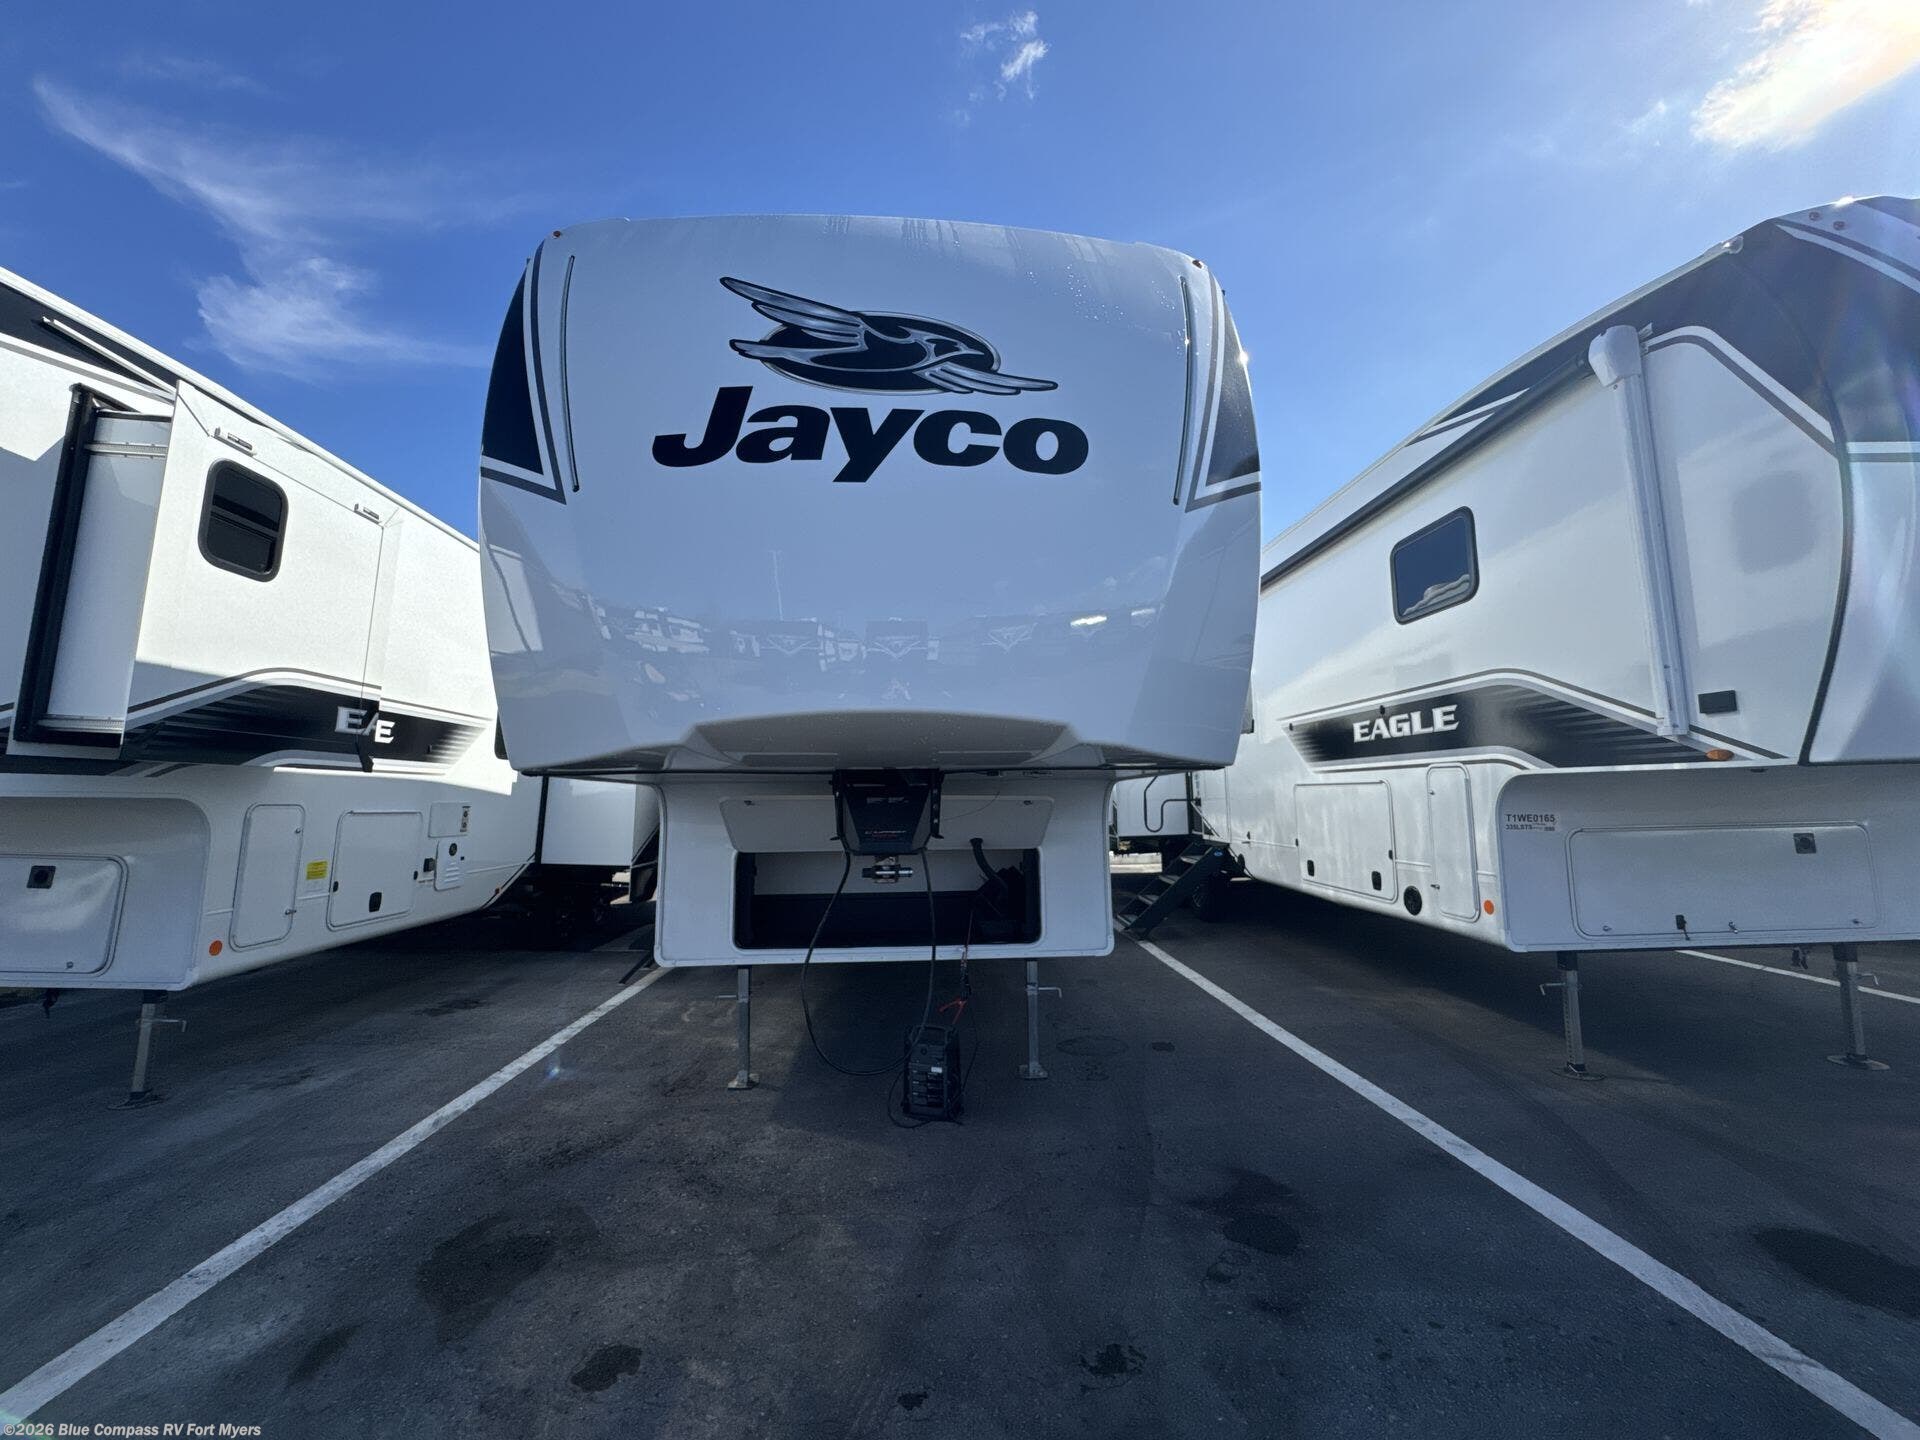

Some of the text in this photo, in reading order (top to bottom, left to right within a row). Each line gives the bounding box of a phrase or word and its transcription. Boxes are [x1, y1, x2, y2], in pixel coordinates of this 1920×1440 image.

[652, 386, 1089, 483] Jayco
[1353, 704, 1459, 743] EAGLE
[1506, 814, 1555, 822] T1WE0165
